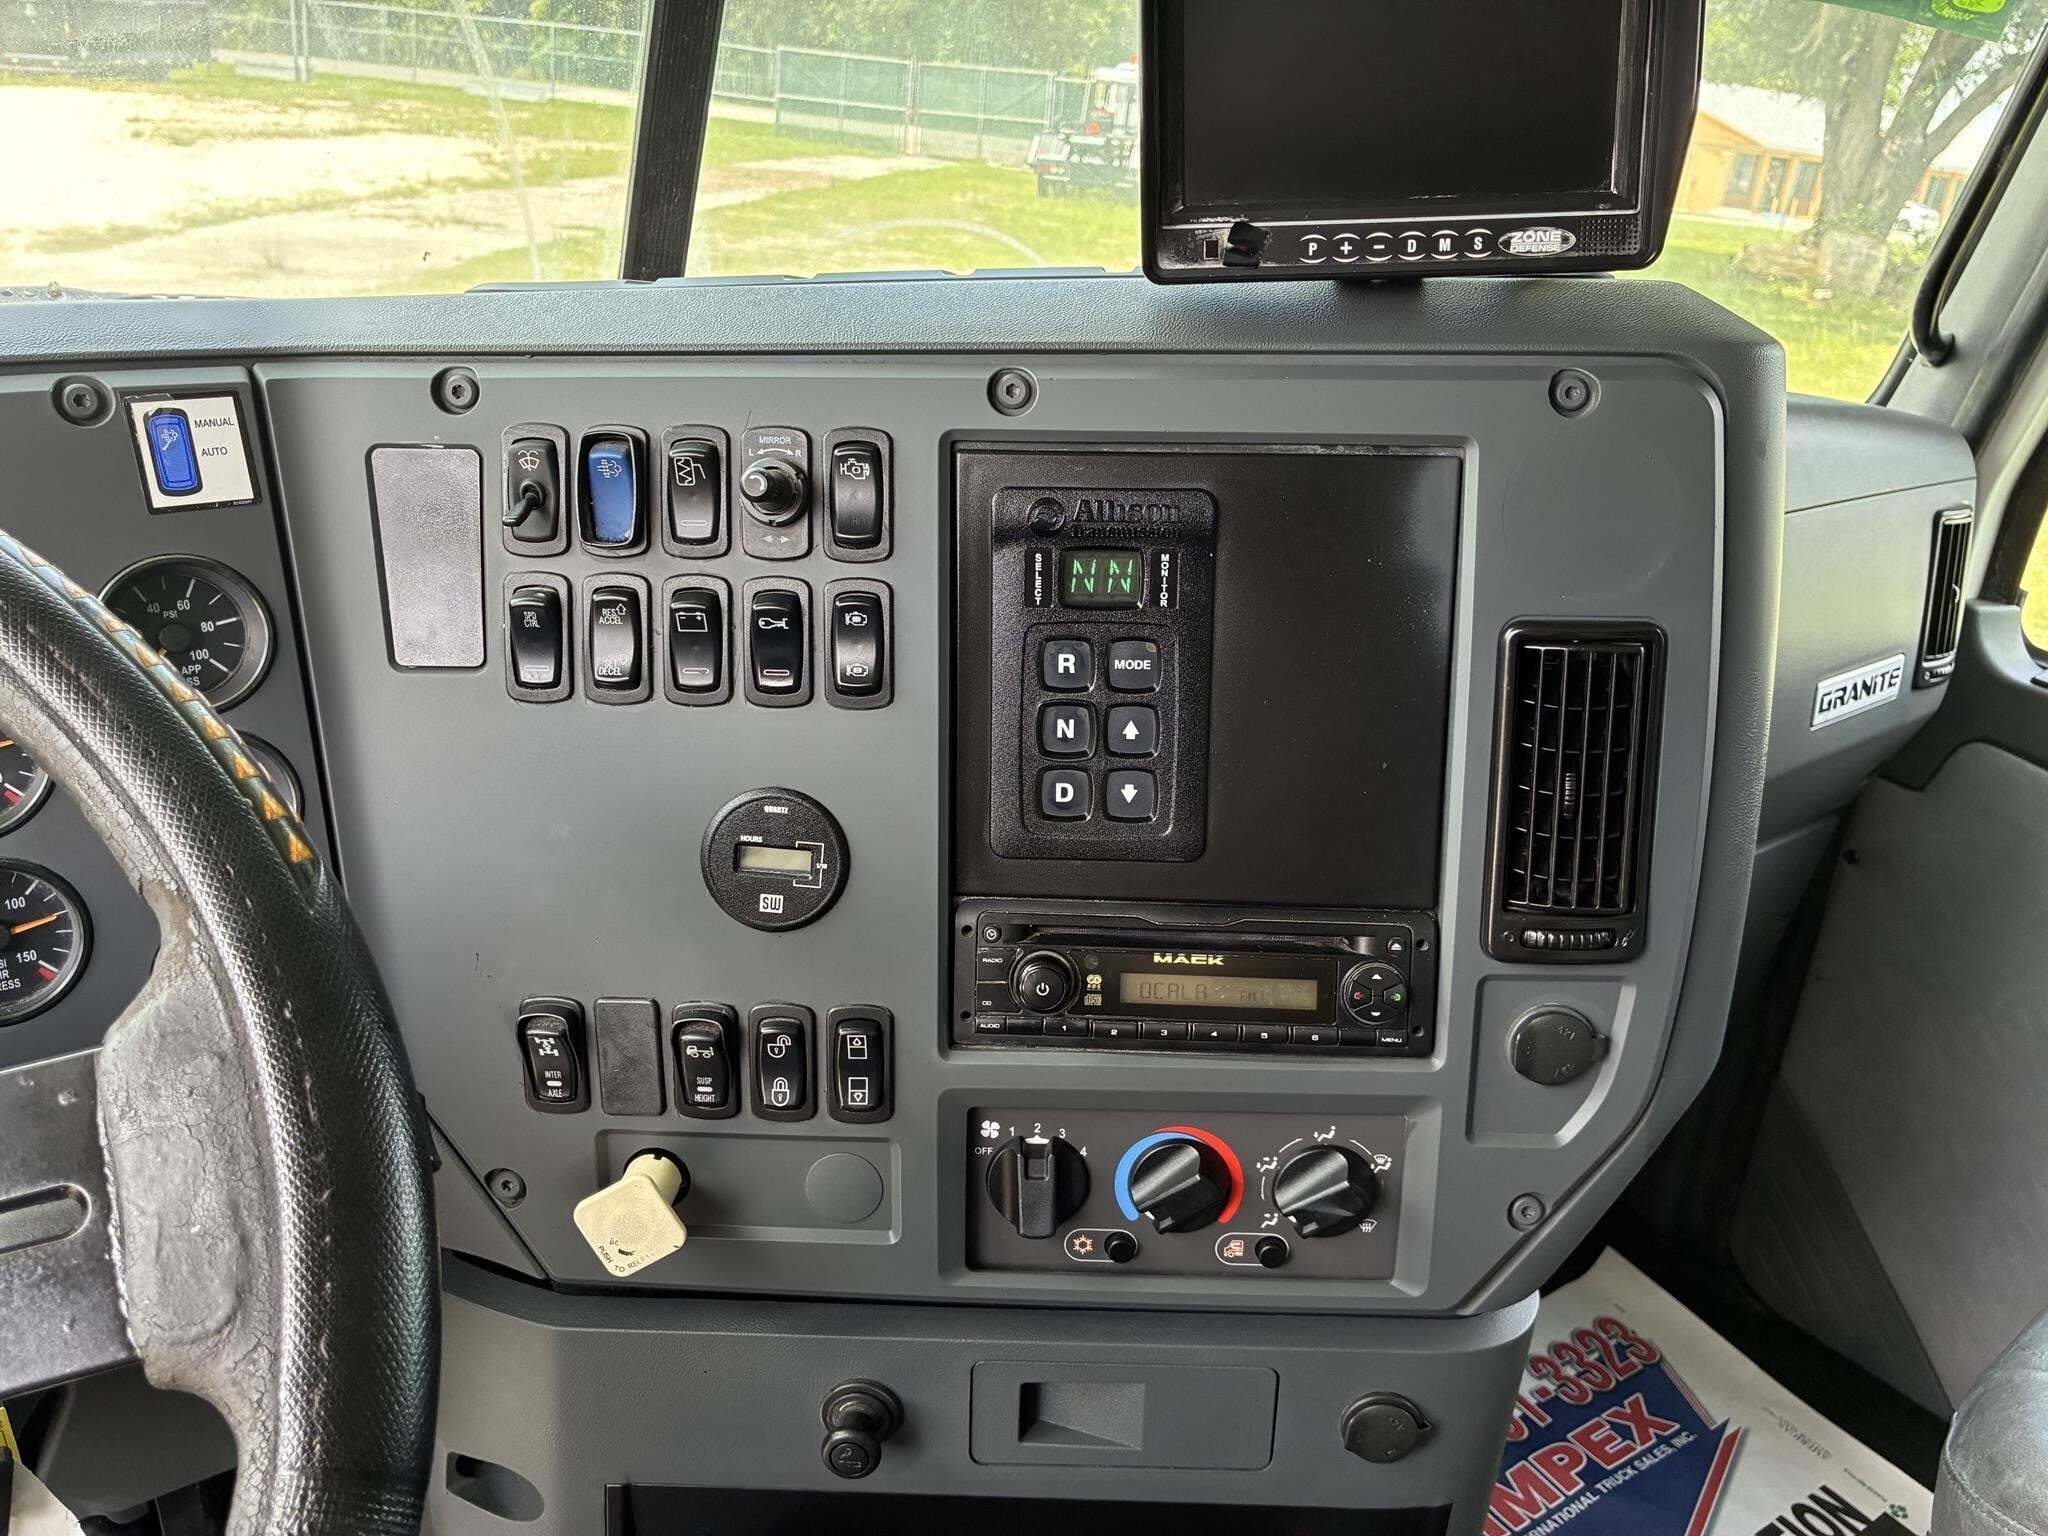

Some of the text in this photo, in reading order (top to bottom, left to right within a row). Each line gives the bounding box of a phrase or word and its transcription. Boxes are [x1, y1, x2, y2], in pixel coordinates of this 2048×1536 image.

[1510, 231, 1562, 243] ZONE
[1308, 242, 1318, 256] P
[1407, 239, 1417, 253] D
[1439, 237, 1451, 252] M
[1473, 236, 1483, 250] S
[1509, 243, 1561, 253] DEFENSE
[194, 417, 235, 428] MANUAL
[758, 436, 791, 445] MIRROR
[201, 446, 228, 457] AUTO
[1034, 553, 1042, 606] SELECT
[1159, 553, 1169, 607] MONITOR
[146, 602, 160, 614] 40
[176, 599, 190, 611] 60
[163, 610, 178, 619] PSI
[602, 608, 616, 617] RES
[598, 616, 624, 625] ACCEL
[200, 621, 214, 632] 80
[189, 648, 209, 661] 100
[1057, 653, 1076, 674] R
[1114, 659, 1151, 670] MODE
[181, 664, 202, 675] APP
[598, 667, 622, 676] DECEL
[1056, 718, 1075, 739] N
[1055, 782, 1074, 803] D
[740, 835, 763, 843] HOURS
[4, 896, 26, 910] 100
[762, 896, 782, 911] SW
[15, 949, 37, 963] 150
[1153, 952, 1224, 966] MACK
[544, 1070, 562, 1079] INTER
[696, 1076, 713, 1085] SUSP
[547, 1089, 563, 1098] AXLE
[694, 1093, 715, 1102] HEIGHT
[1009, 1126, 1015, 1137] 1
[1034, 1122, 1041, 1133] 2
[1058, 1128, 1066, 1138] 3
[974, 1147, 994, 1155] OFF
[1079, 1146, 1087, 1157] 4
[615, 1265, 625, 1273] TO
[1594, 1466, 1638, 1495] TRUCK
